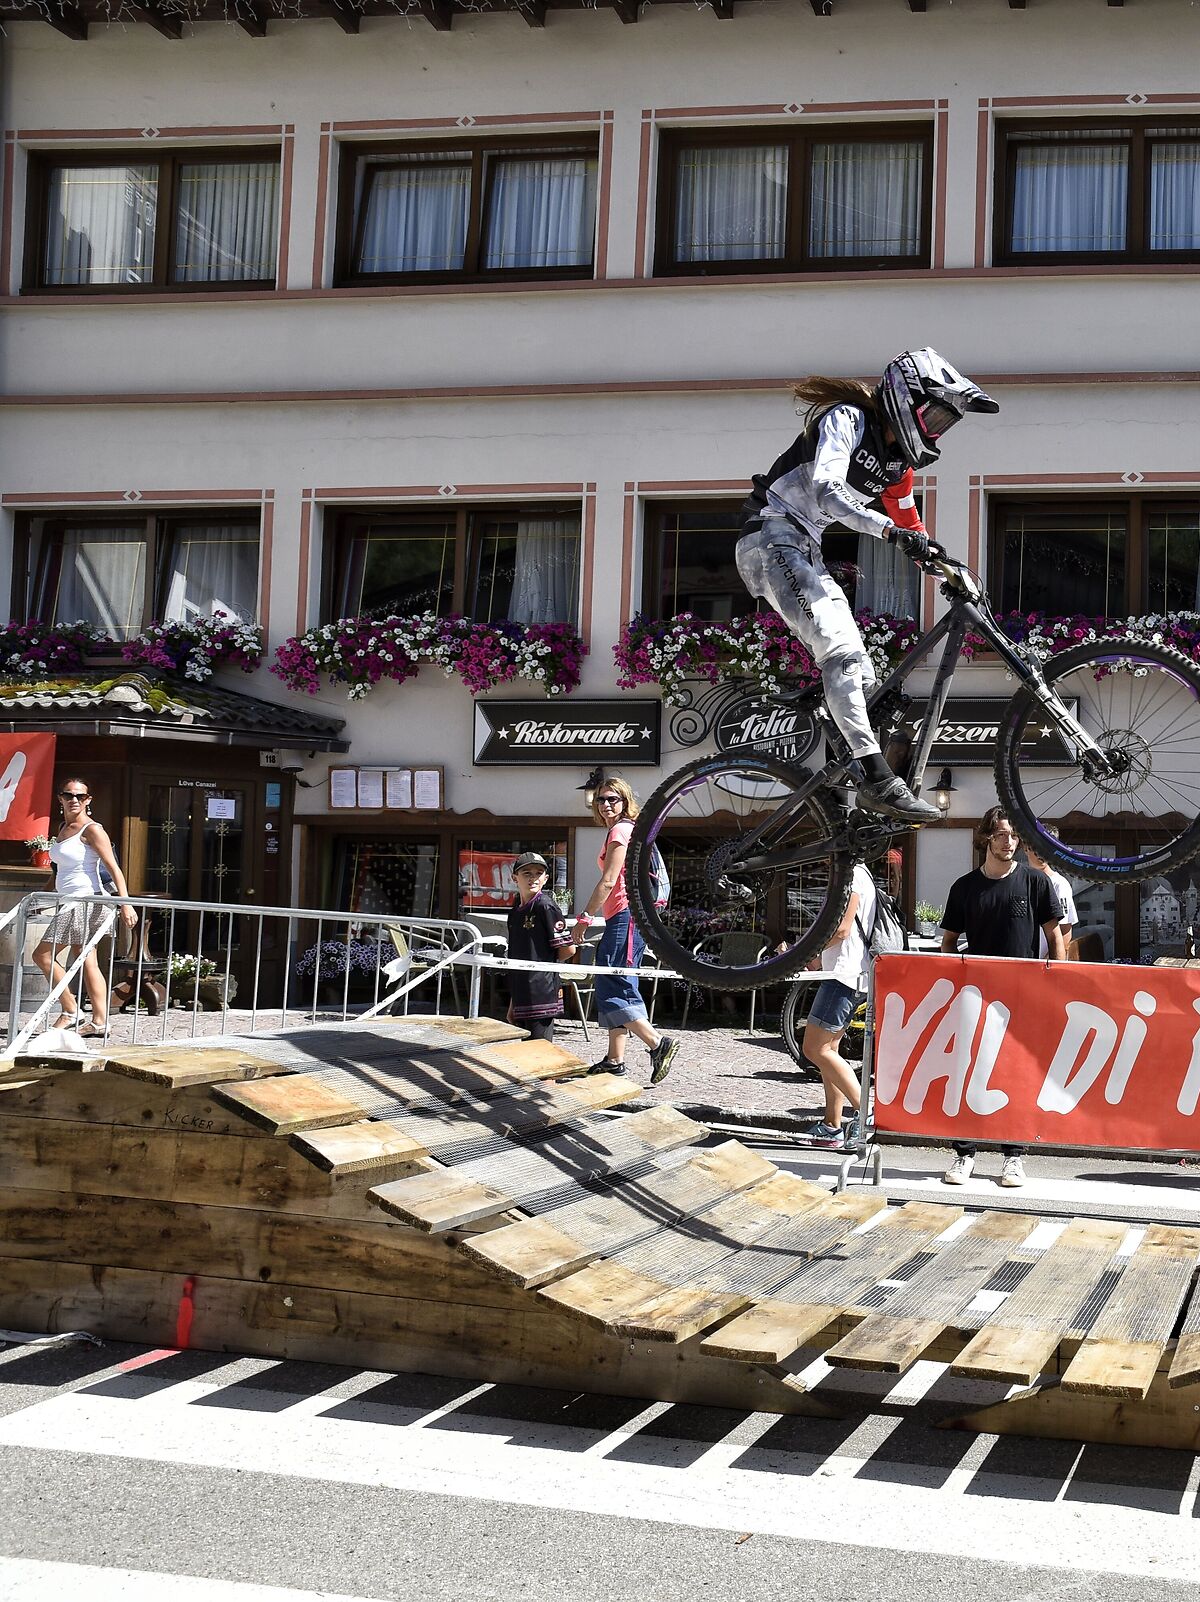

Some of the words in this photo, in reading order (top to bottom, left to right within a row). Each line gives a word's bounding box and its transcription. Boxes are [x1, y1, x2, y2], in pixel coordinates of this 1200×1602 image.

[514, 720, 635, 744] Ristorante
[912, 719, 999, 742] Pizzer
[265, 754, 276, 764] 118
[632, 841, 644, 888] MAGIC
[1053, 850, 1095, 871] FIRST
[1096, 864, 1130, 873] RIDE
[877, 978, 1011, 1117] VAL
[164, 1108, 215, 1131] KICKER
